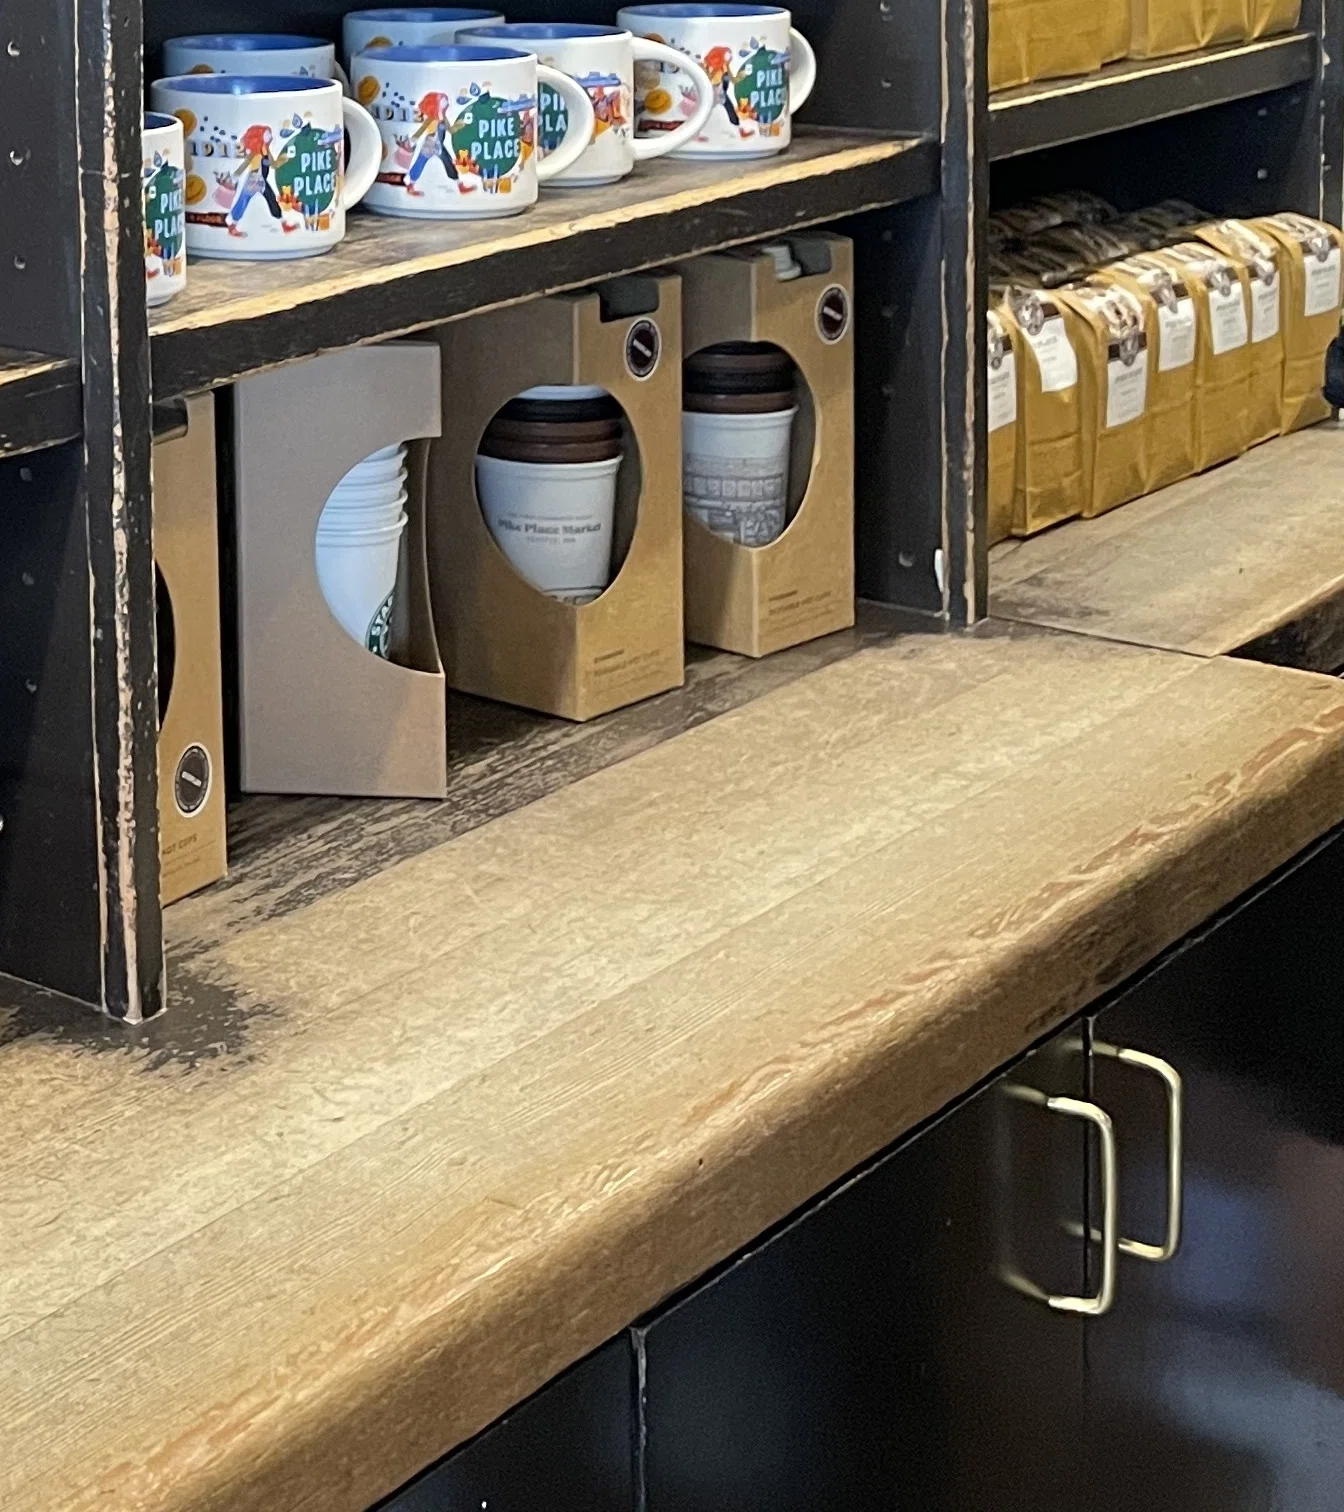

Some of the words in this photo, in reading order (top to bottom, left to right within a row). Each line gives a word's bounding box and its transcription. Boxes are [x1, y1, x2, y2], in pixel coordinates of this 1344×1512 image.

[478, 117, 516, 138] PIKE
[538, 114, 567, 132] PLA
[470, 139, 521, 161] PLACE
[301, 149, 332, 174] PIKE
[293, 174, 337, 196] PLACE
